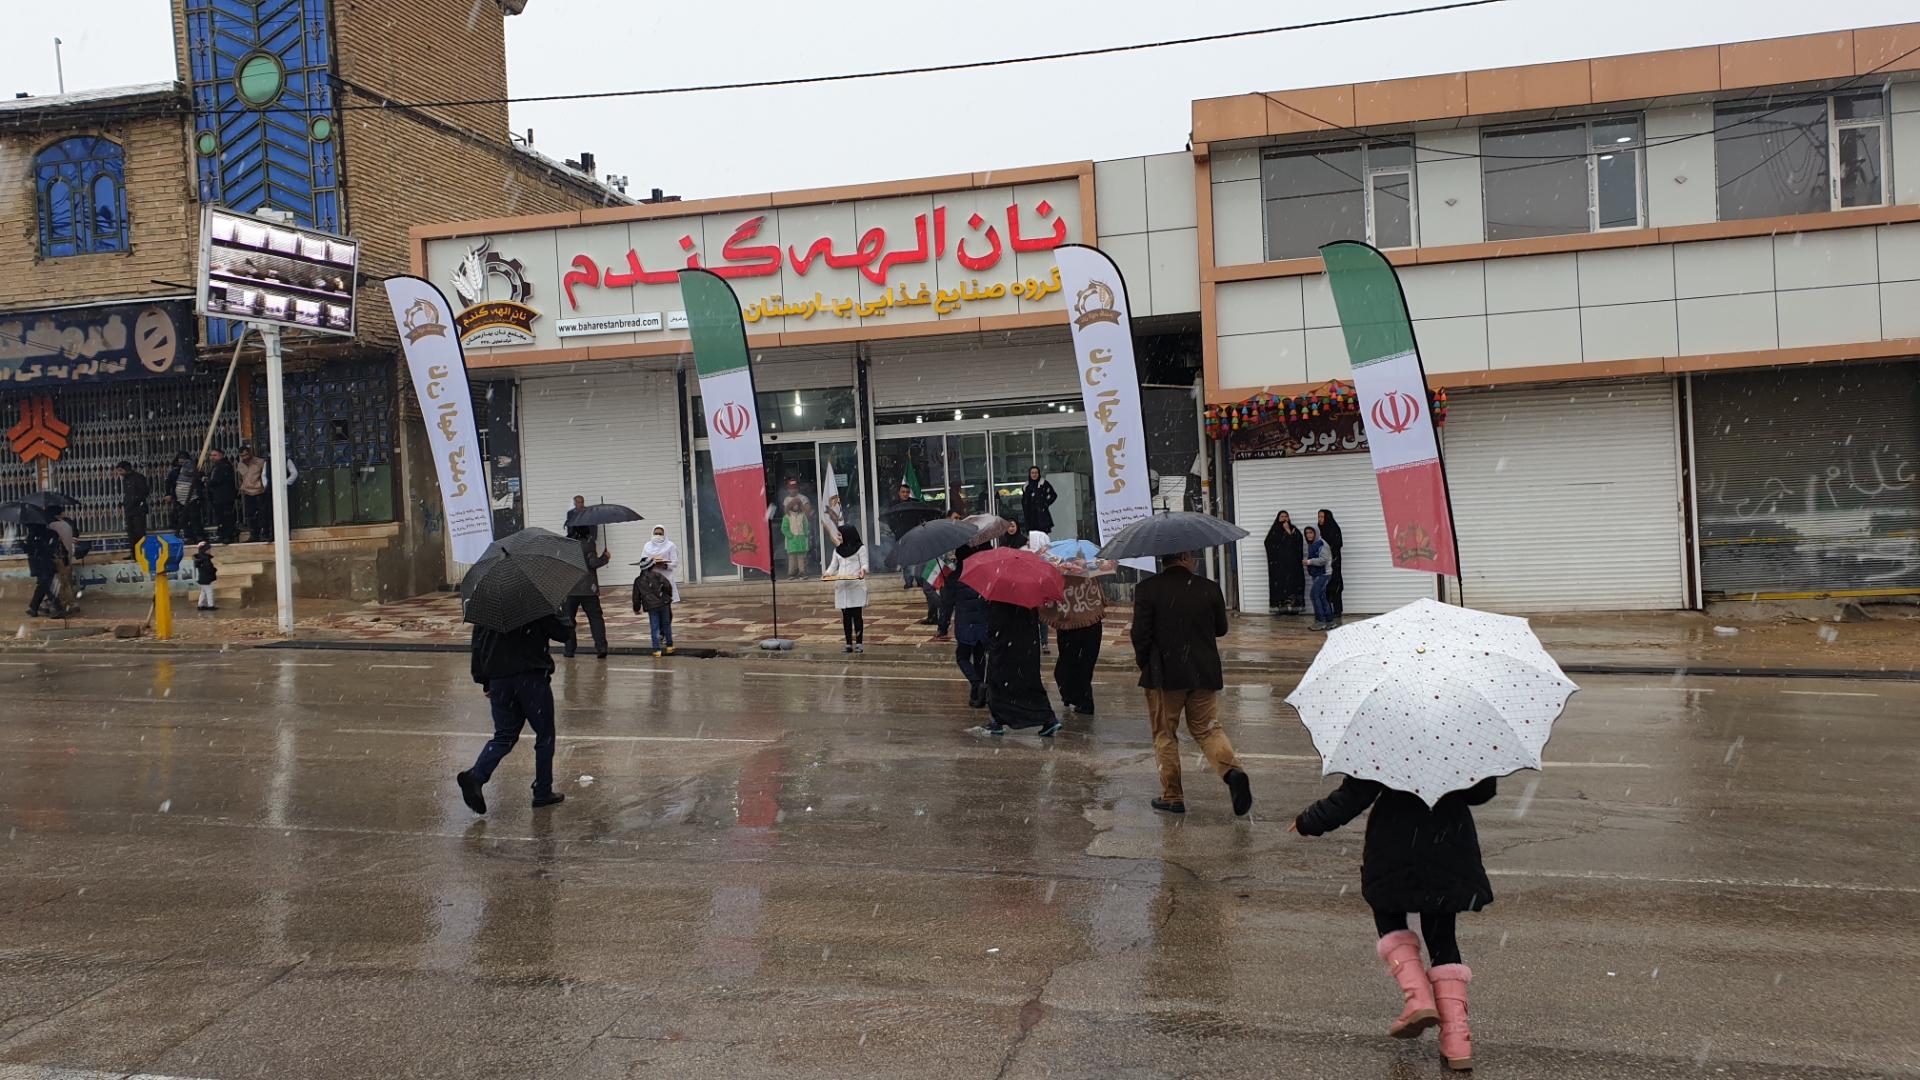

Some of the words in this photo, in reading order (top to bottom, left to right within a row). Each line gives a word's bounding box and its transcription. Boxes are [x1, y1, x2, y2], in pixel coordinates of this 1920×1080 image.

[788, 205, 947, 286] الهه
[956, 199, 1067, 271] نان
[563, 215, 784, 311] گندم
[743, 292, 852, 323] بهارستان
[854, 281, 931, 317] غذایی
[932, 279, 1005, 314] صنایع
[558, 316, 659, 333] www.baharestanbread.com
